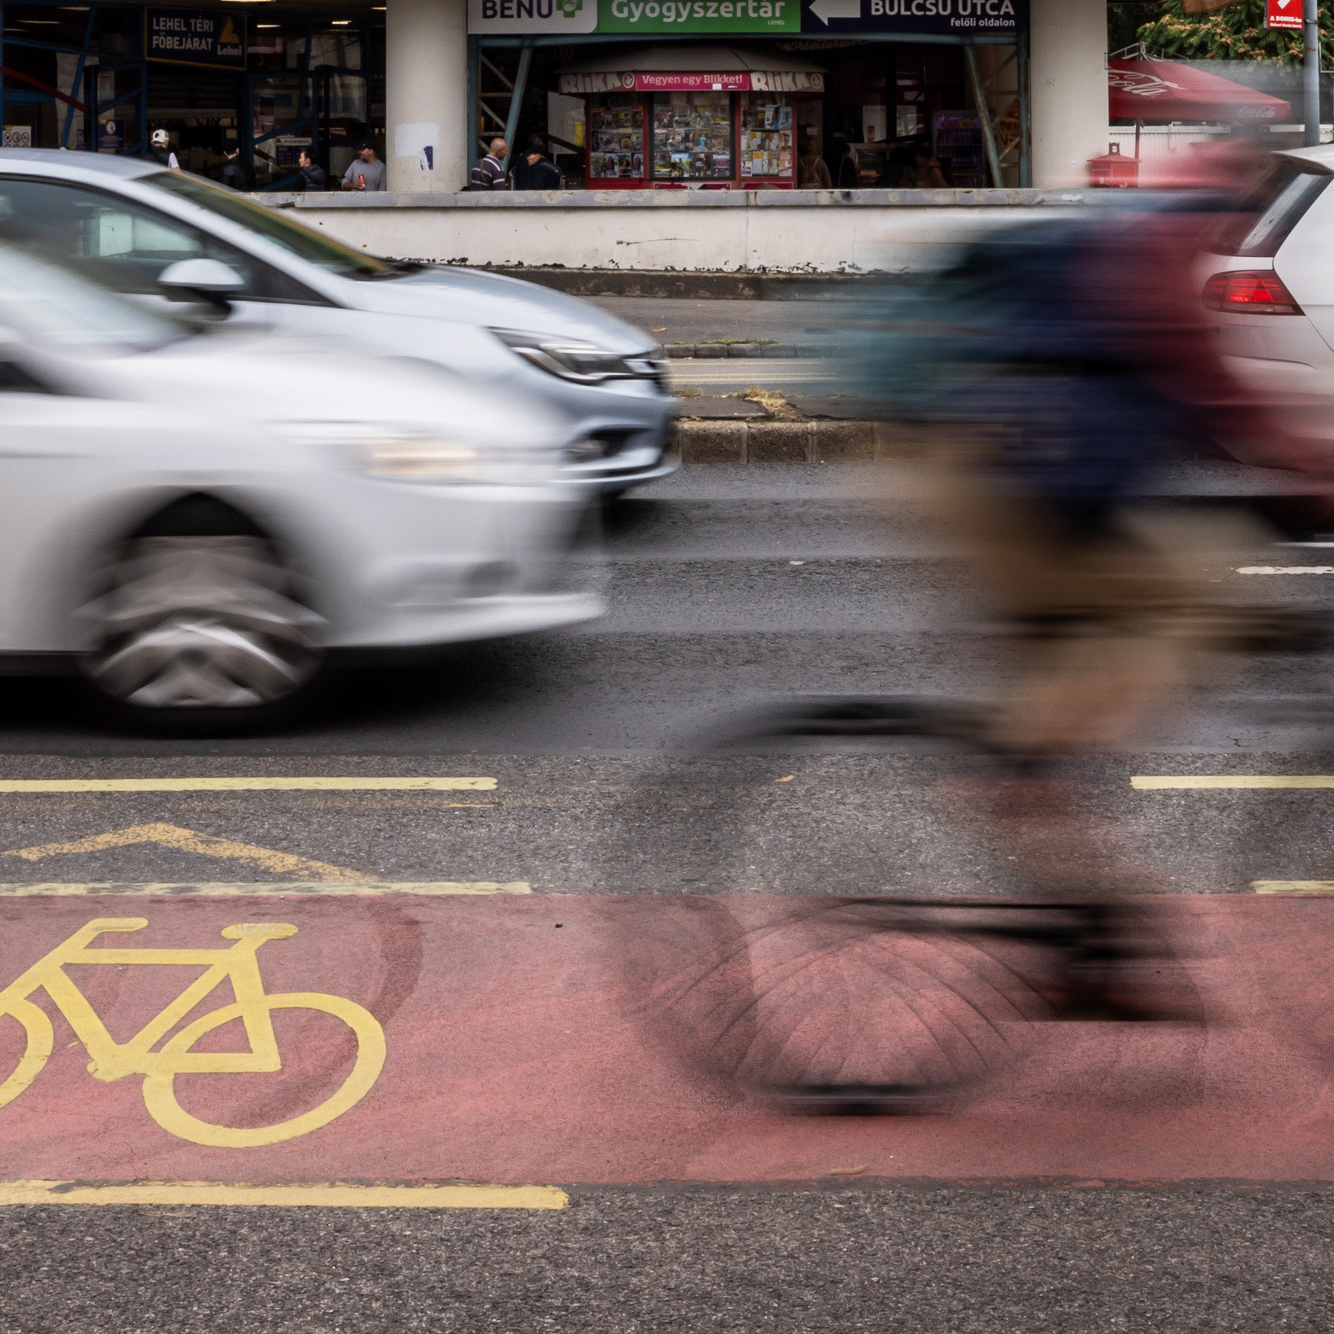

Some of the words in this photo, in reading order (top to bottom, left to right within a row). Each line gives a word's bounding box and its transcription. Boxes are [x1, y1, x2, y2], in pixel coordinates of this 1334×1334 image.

[958, 0, 1015, 16] UTCA
[152, 16, 187, 31] LEHEL
[189, 14, 214, 32] TÉRI
[979, 17, 1015, 27] oldalon
[152, 31, 213, 51] FŐBEJÁRAT
[217, 44, 242, 56] Lehel
[642, 74, 681, 87] Vegyen
[682, 76, 701, 87] egy
[703, 73, 743, 84] Blikket!
